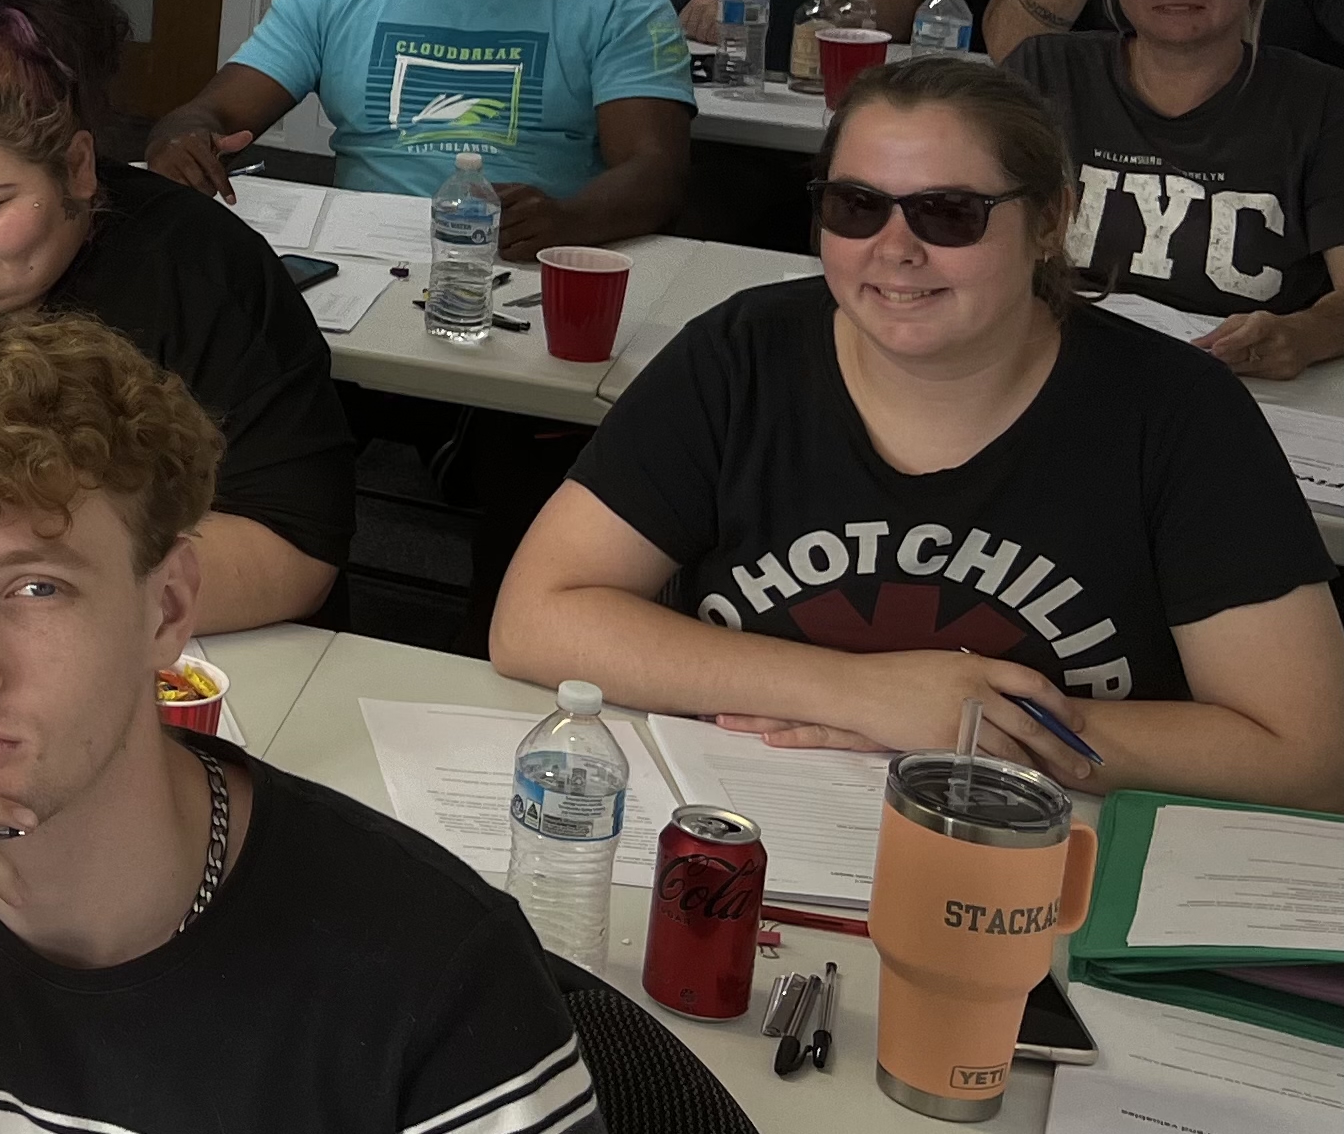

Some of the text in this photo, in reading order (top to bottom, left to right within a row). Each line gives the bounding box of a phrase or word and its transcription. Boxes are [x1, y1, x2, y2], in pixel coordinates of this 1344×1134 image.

[396, 40, 523, 60] CLOUDBREAK
[440, 143, 499, 155] ISLANDS
[732, 521, 1117, 659] HOT CHILI
[658, 852, 758, 922] Cola
[958, 1067, 1004, 1086] YETI
